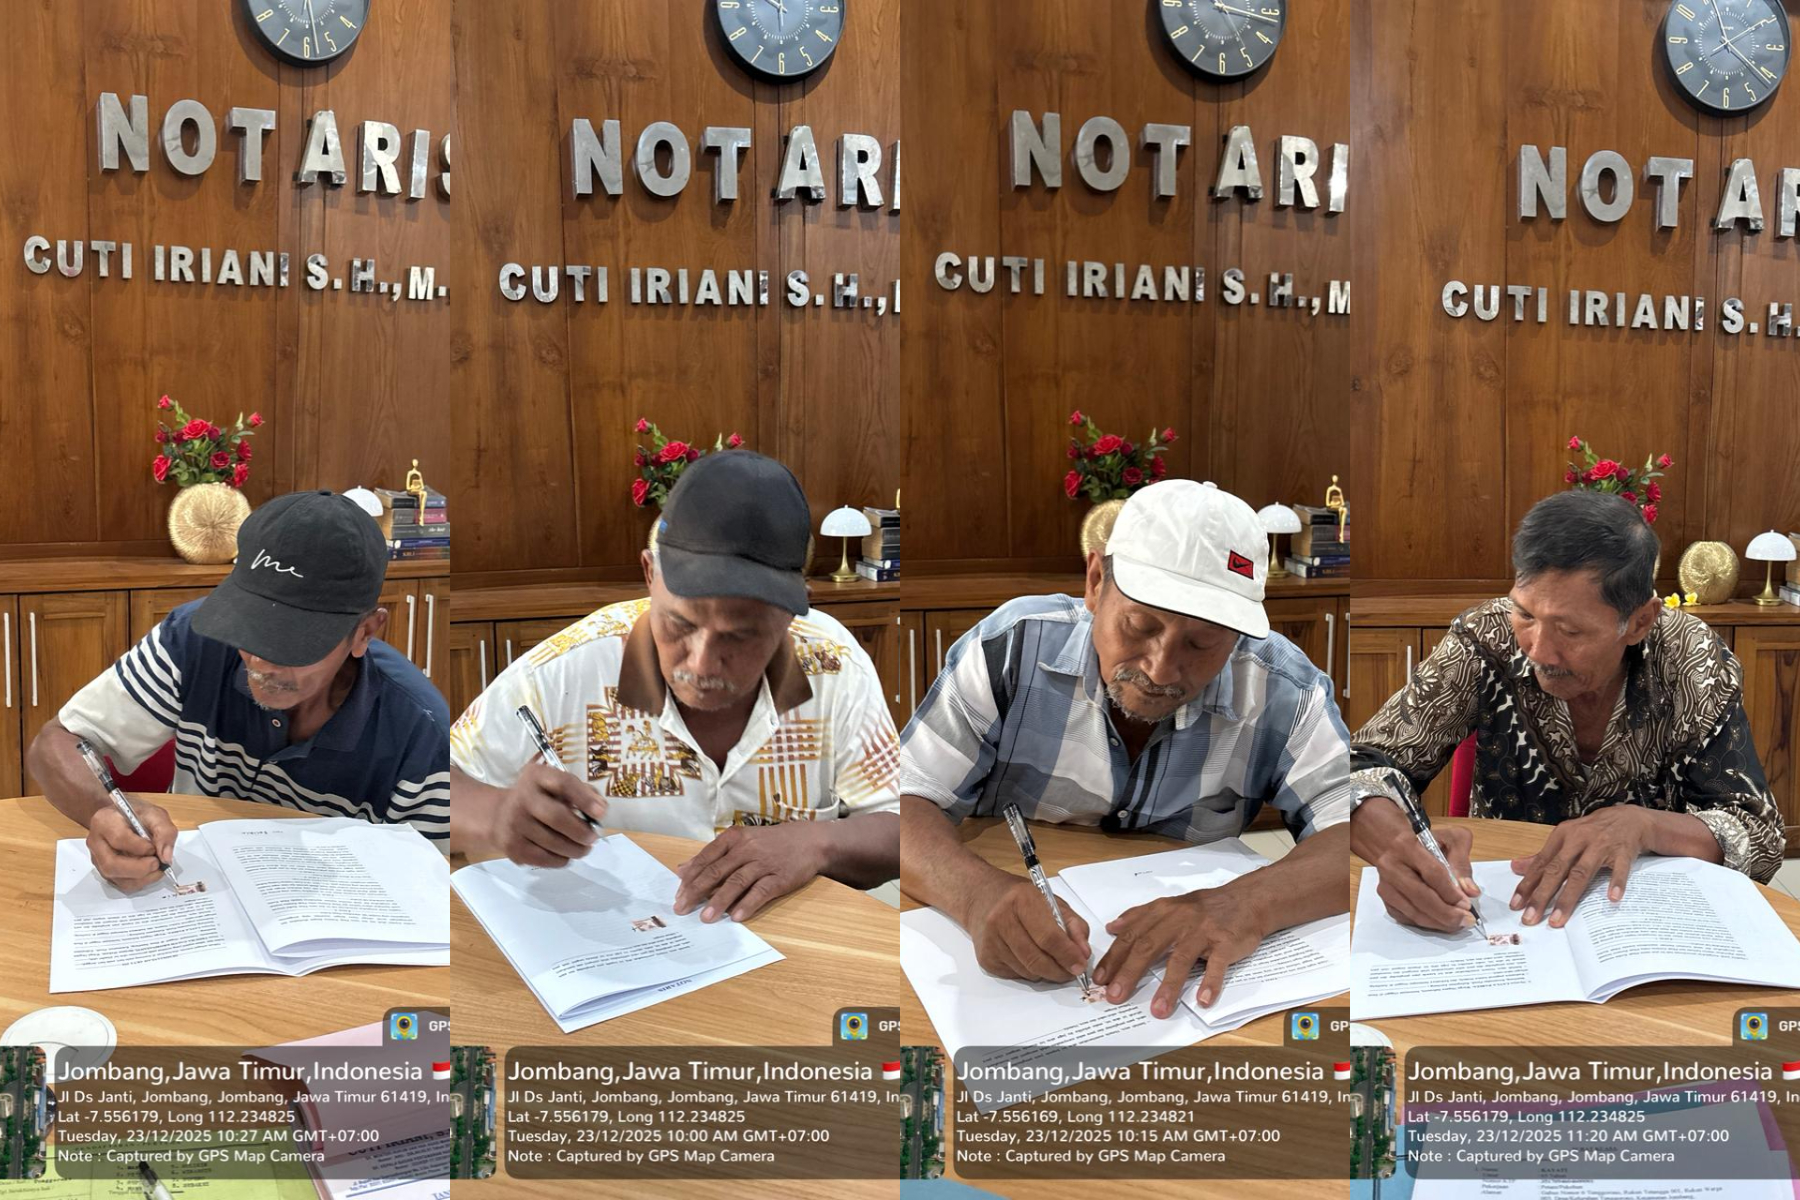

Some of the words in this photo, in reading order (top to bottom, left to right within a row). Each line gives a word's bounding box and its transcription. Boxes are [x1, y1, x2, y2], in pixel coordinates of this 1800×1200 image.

[720, 1, 740, 9] 9
[1261, 7, 1280, 16] 3
[256, 9, 274, 23] 8
[340, 15, 357, 29] 4
[277, 28, 290, 46] 7
[728, 27, 747, 41] 8
[815, 29, 833, 42] 4
[1170, 25, 1188, 39] 8
[1255, 31, 1273, 44] 4
[1669, 36, 1688, 44] 9
[303, 36, 310, 59] 6
[324, 31, 337, 52] 5
[750, 45, 764, 63] 7
[799, 46, 813, 67] 5
[1191, 44, 1205, 62] 7
[1240, 46, 1253, 67] 5
[778, 52, 785, 74] 6
[1219, 52, 1226, 74] 6
[1676, 61, 1694, 75] 8
[1760, 66, 1777, 79] 4
[1696, 79, 1709, 97] 7
[1744, 81, 1757, 102] 5
[1723, 87, 1730, 108] 6
[23, 235, 132, 279] CUTI
[154, 245, 289, 287] IRIANI
[934, 252, 1044, 295] CUTI
[1067, 260, 1205, 302] IRIANI
[499, 262, 608, 303] CUTI
[630, 267, 769, 305] IRIANI
[786, 269, 900, 316] S.H.,
[1442, 280, 1548, 323] CUTI
[1569, 289, 1704, 331] IRIANI
